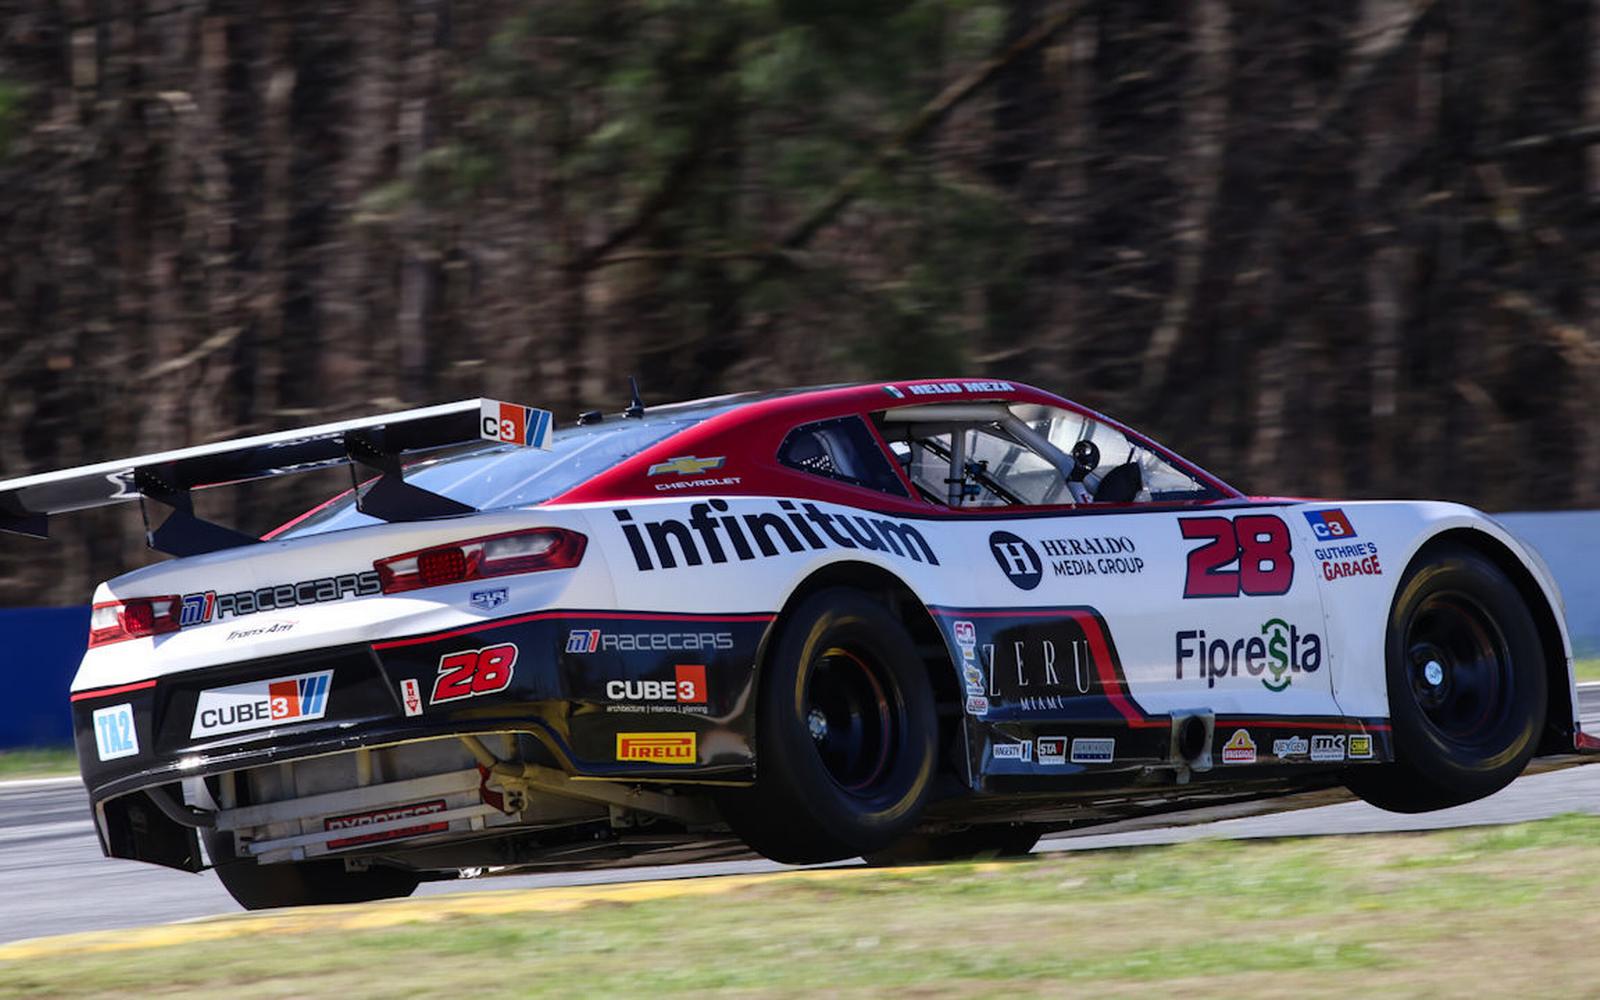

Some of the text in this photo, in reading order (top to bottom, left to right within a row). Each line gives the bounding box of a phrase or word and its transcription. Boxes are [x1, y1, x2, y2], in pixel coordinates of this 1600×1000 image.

[908, 381, 1016, 395] HELIO MEZA
[483, 416, 516, 441] C3
[655, 476, 743, 491] CHEVROLET
[613, 499, 940, 572] infinitum
[1313, 521, 1344, 537] C3
[1040, 535, 1136, 556] HERALDO
[1314, 541, 1378, 562] GUTHRIE'S
[1051, 556, 1144, 577] MEDIA GROUP
[1177, 514, 1294, 599] 28
[1322, 556, 1383, 581] GARAGE
[429, 642, 519, 706] 28
[982, 639, 1092, 697] ZERU
[1020, 694, 1064, 711] MIAMI
[97, 710, 135, 755] TA2
[621, 738, 692, 758] PIRELLI
